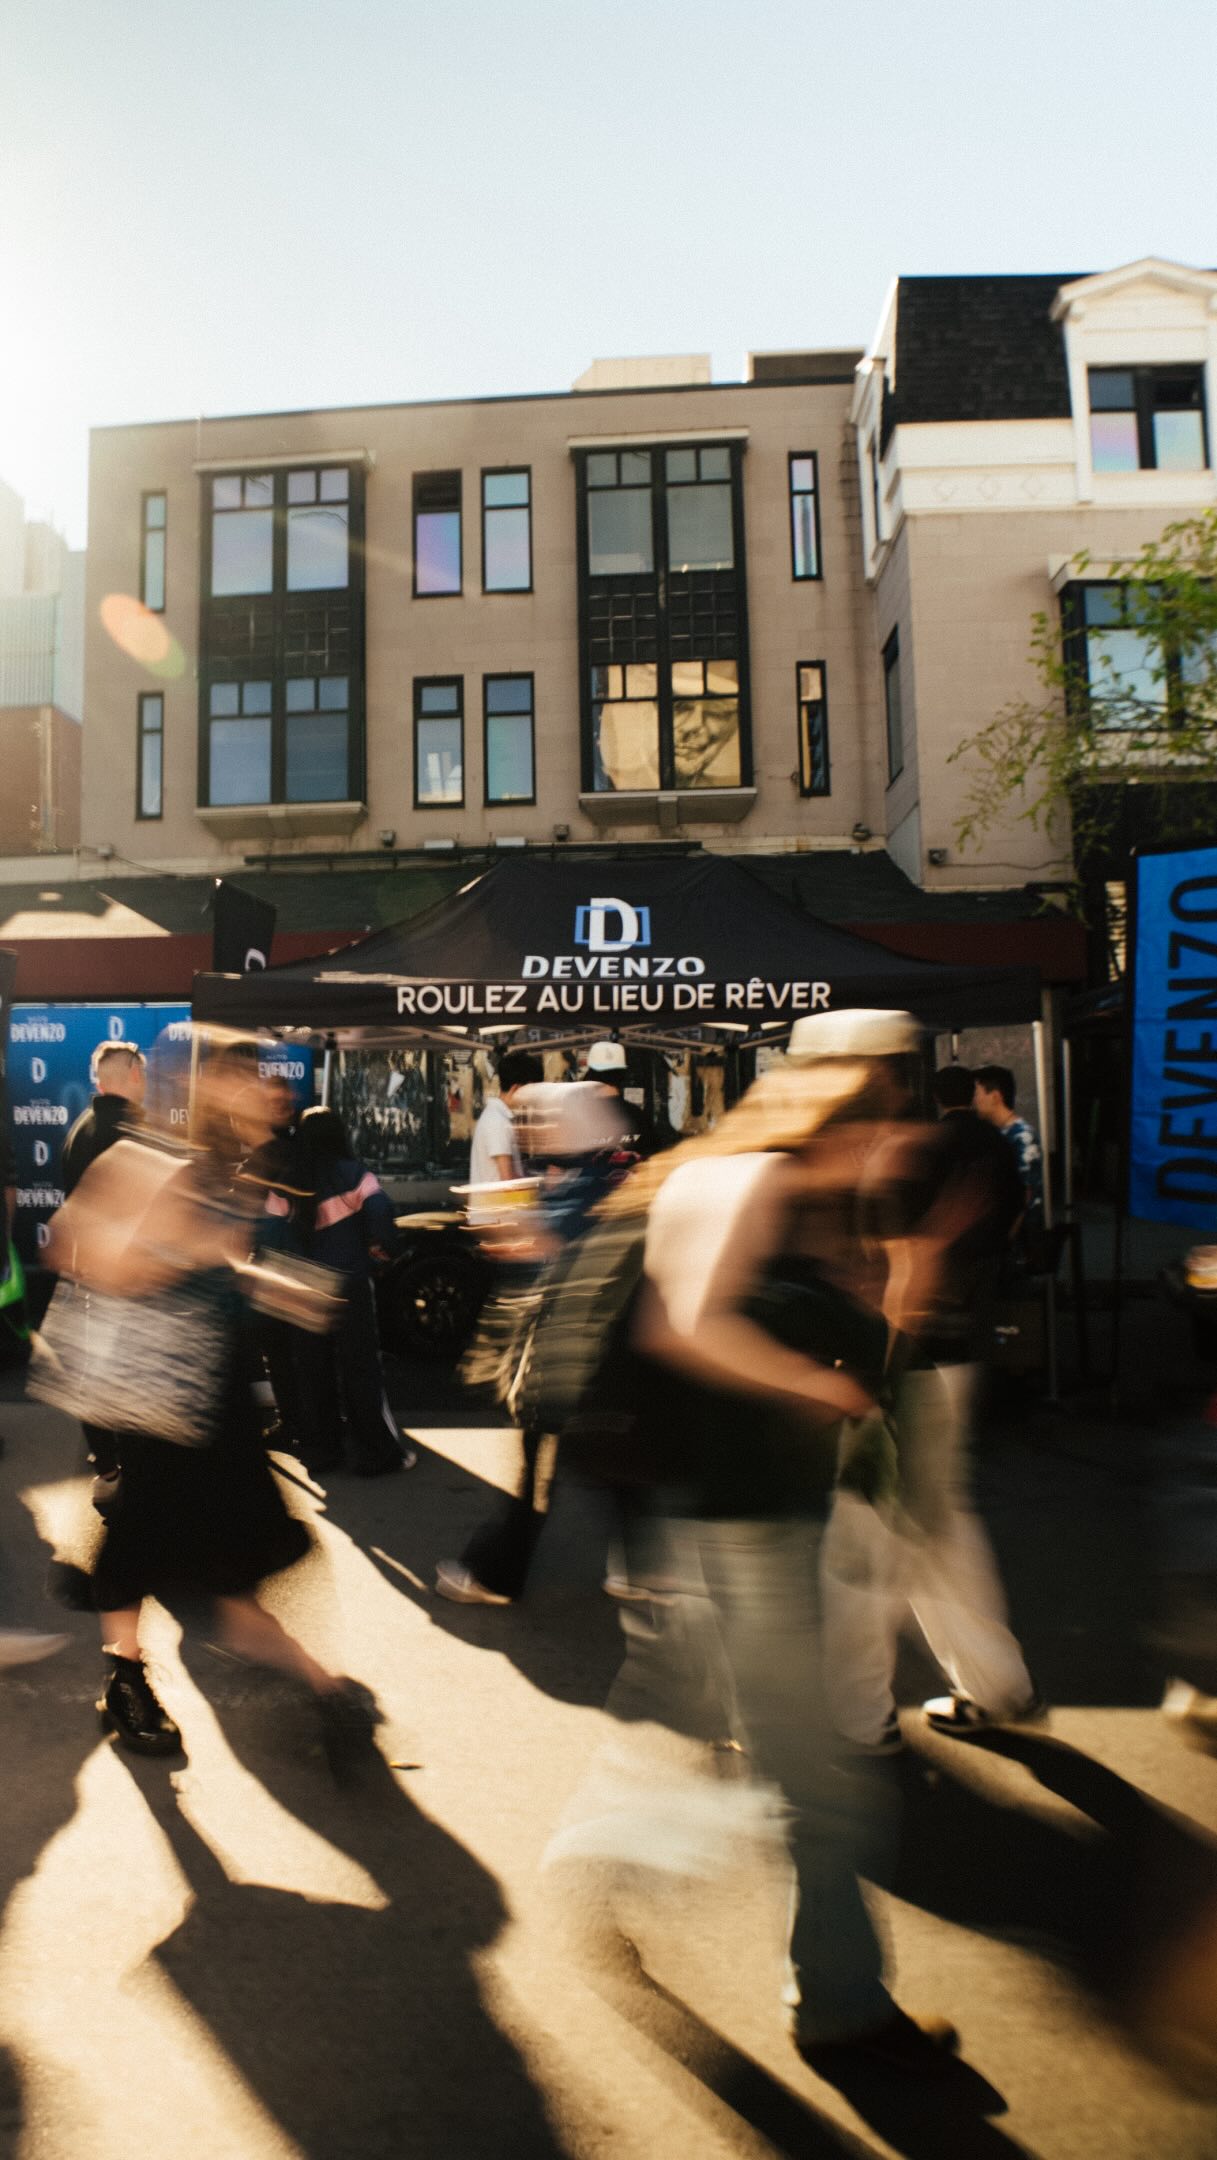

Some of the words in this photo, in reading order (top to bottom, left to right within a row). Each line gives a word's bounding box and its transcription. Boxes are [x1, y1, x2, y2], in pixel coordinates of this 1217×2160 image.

[521, 955, 706, 979] DEVENZO
[396, 984, 527, 1014] ROULEZ
[536, 984, 584, 1013] AU
[593, 983, 664, 1012] LIEU
[673, 982, 716, 1011] DE
[725, 976, 832, 1010] RÊVER
[10, 1022, 67, 1042] DEVENZO
[108, 1015, 124, 1041] D
[31, 1056, 46, 1083] D
[258, 1061, 305, 1080] EVENZO
[13, 1104, 69, 1125] DEVENZO
[34, 1139, 48, 1167] D
